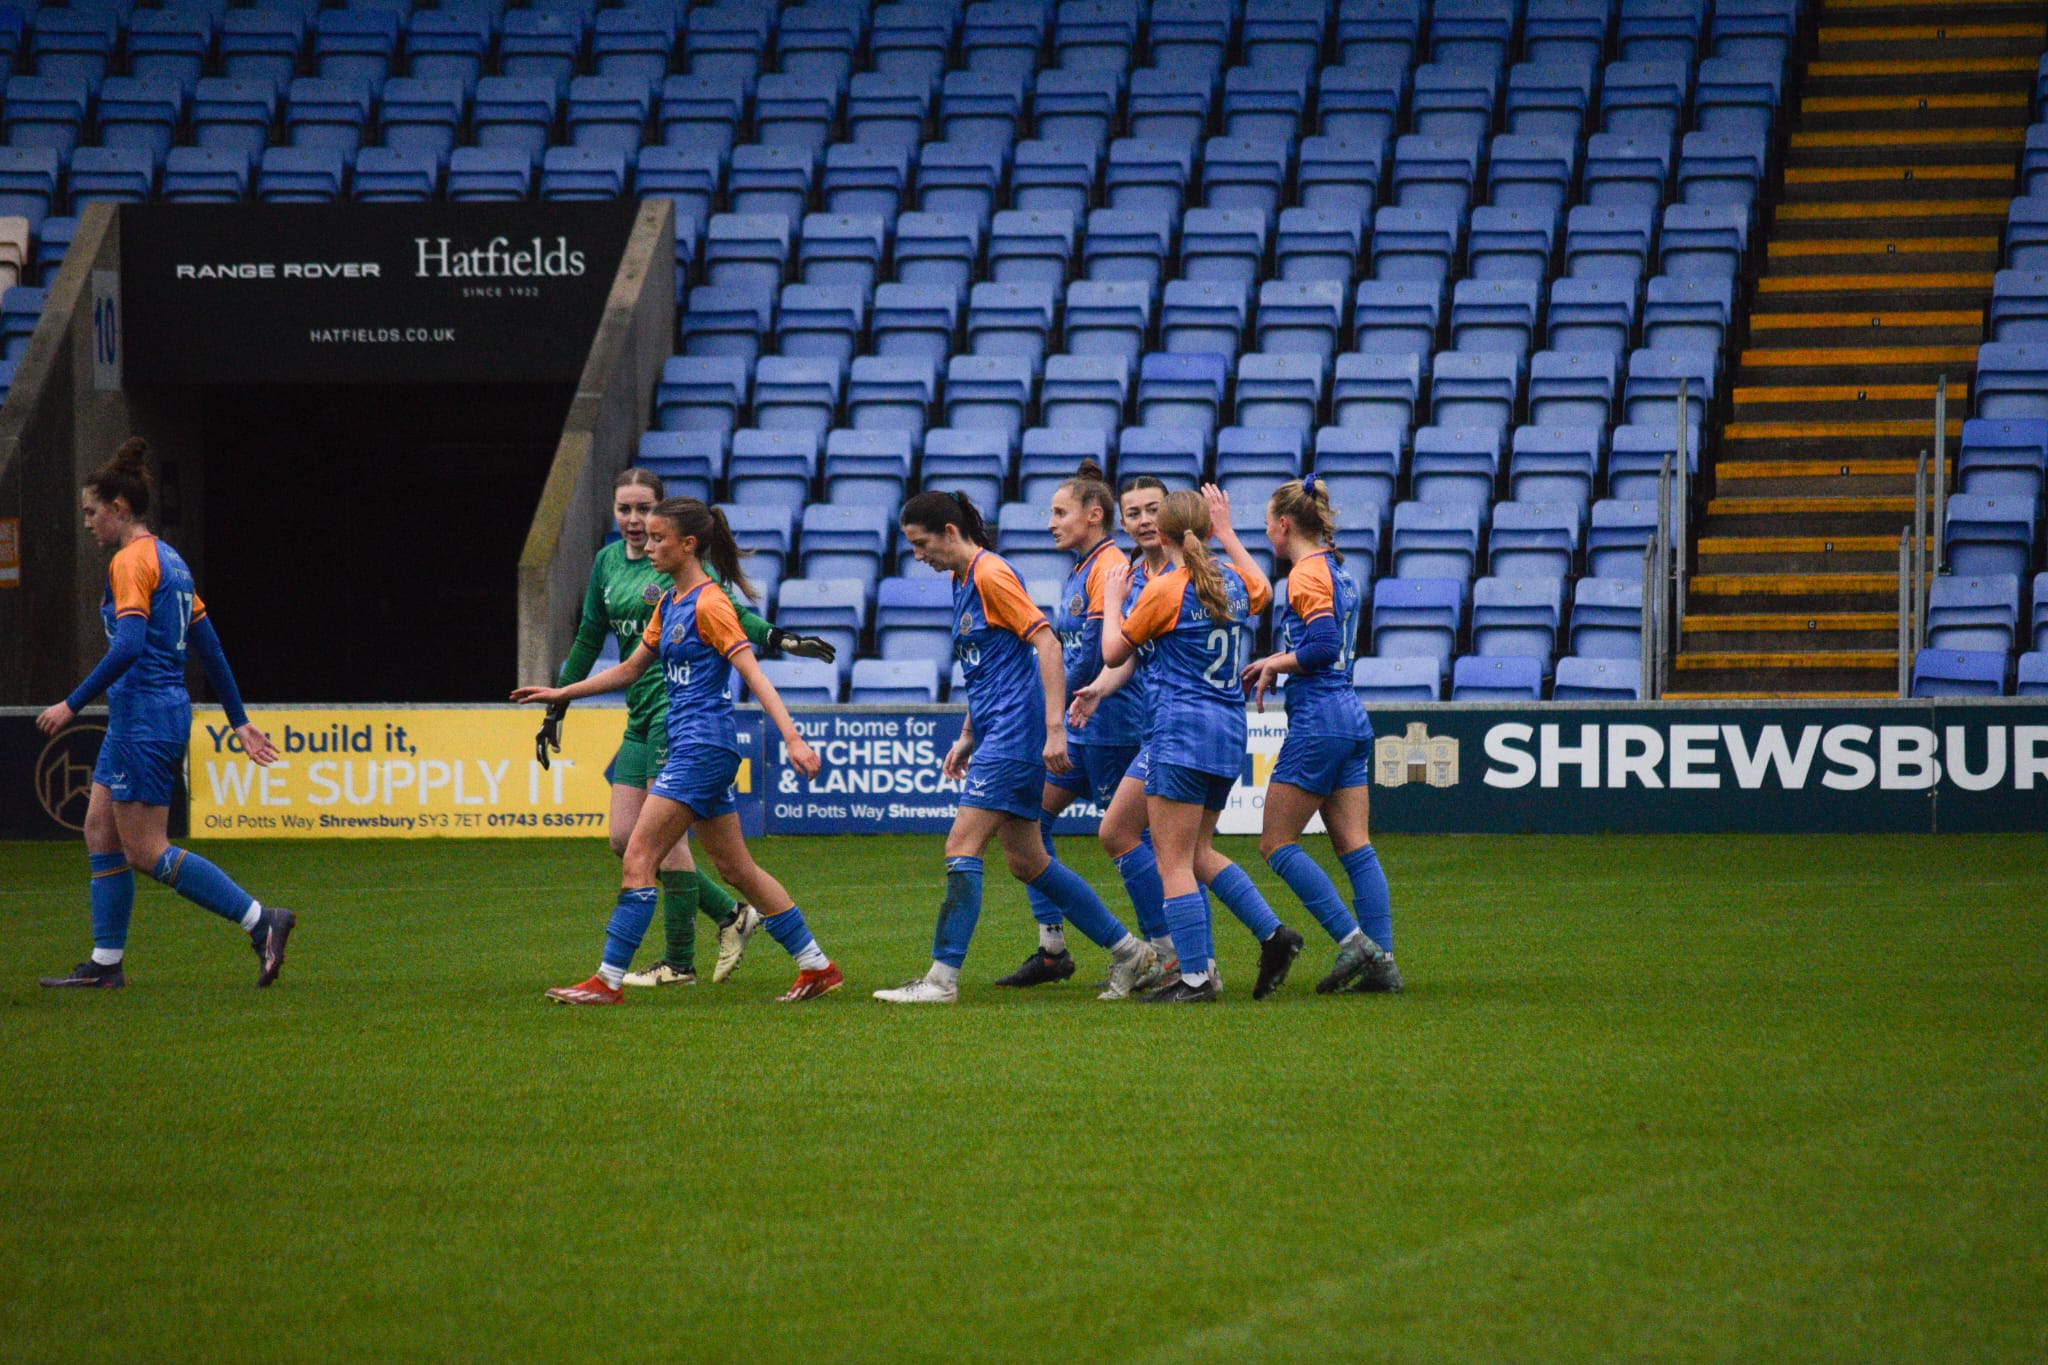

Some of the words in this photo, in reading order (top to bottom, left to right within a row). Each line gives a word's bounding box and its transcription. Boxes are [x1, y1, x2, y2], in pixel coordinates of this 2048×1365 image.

[176, 264, 276, 279] RANGE
[283, 263, 380, 278] ROVER
[415, 237, 586, 277] Hatfields
[463, 288, 502, 298] SINCE
[95, 298, 115, 365] 10
[310, 328, 456, 343] HATFIELDS.CO.UK
[176, 590, 193, 650] 17
[1203, 626, 1241, 689] 21
[205, 725, 271, 753] Yo
[284, 724, 372, 753] build
[385, 723, 416, 757] it,
[790, 717, 829, 737] our
[835, 717, 899, 737] home
[905, 716, 936, 737] for
[778, 740, 943, 768] KTCHENS,
[1483, 722, 2048, 791] SHREWSBUR
[205, 760, 292, 806] WE
[306, 760, 510, 805] SUPPLY
[528, 758, 575, 805] IT
[778, 768, 799, 794] &
[204, 814, 232, 829] Old
[237, 814, 277, 828] Potts
[281, 814, 315, 830] Way
[319, 813, 415, 830] Shrewsbury
[418, 814, 449, 827] SY3
[453, 814, 482, 827] 7ET
[487, 813, 538, 826] 01743
[542, 813, 605, 826] 636777
[774, 804, 802, 819] Old
[807, 804, 847, 818] Potts
[852, 804, 884, 821] Way
